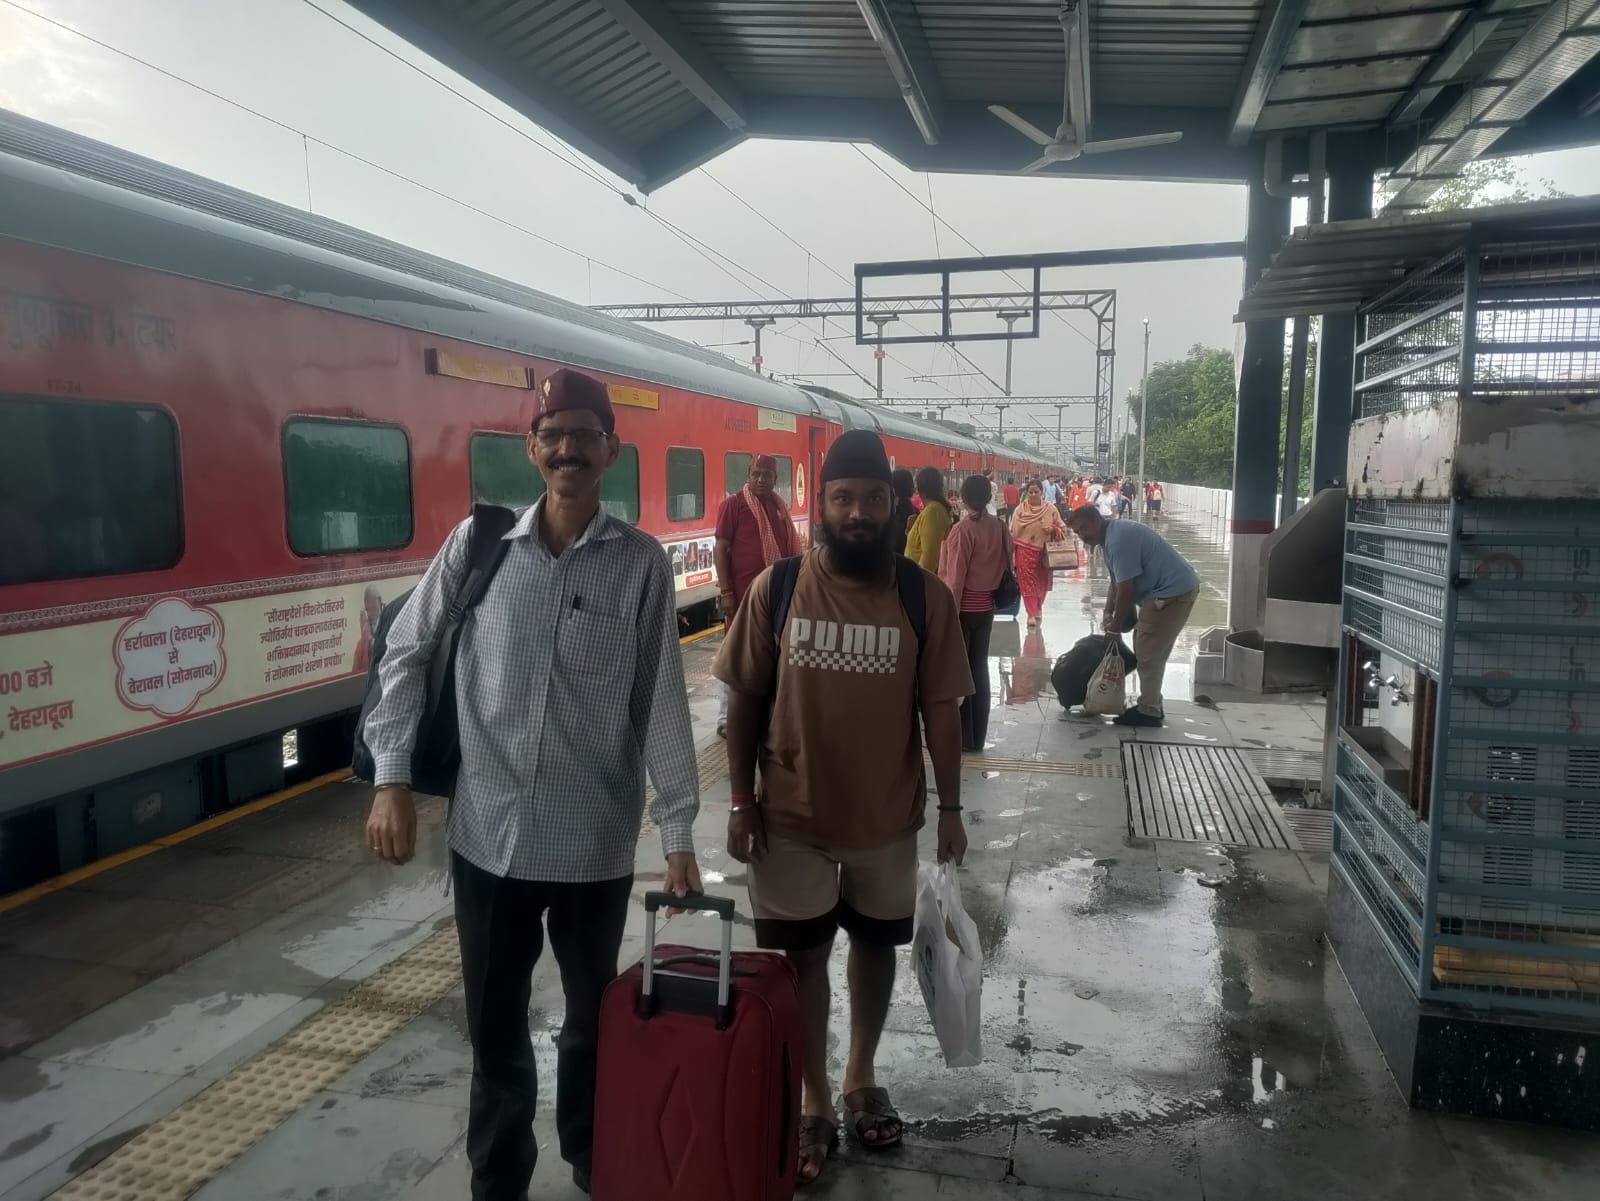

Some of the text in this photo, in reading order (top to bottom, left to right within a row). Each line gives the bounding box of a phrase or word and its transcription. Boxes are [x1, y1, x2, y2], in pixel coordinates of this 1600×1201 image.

[123, 620, 216, 651] हर्रावाला (देहरादून)
[789, 617, 900, 657] PUMA
[168, 647, 179, 664] से
[305, 656, 323, 673] शरणं
[25, 660, 54, 688] बजे
[127, 660, 217, 694] वेरावल (सोमनाथ)
[8, 699, 74, 731] देहरादून
